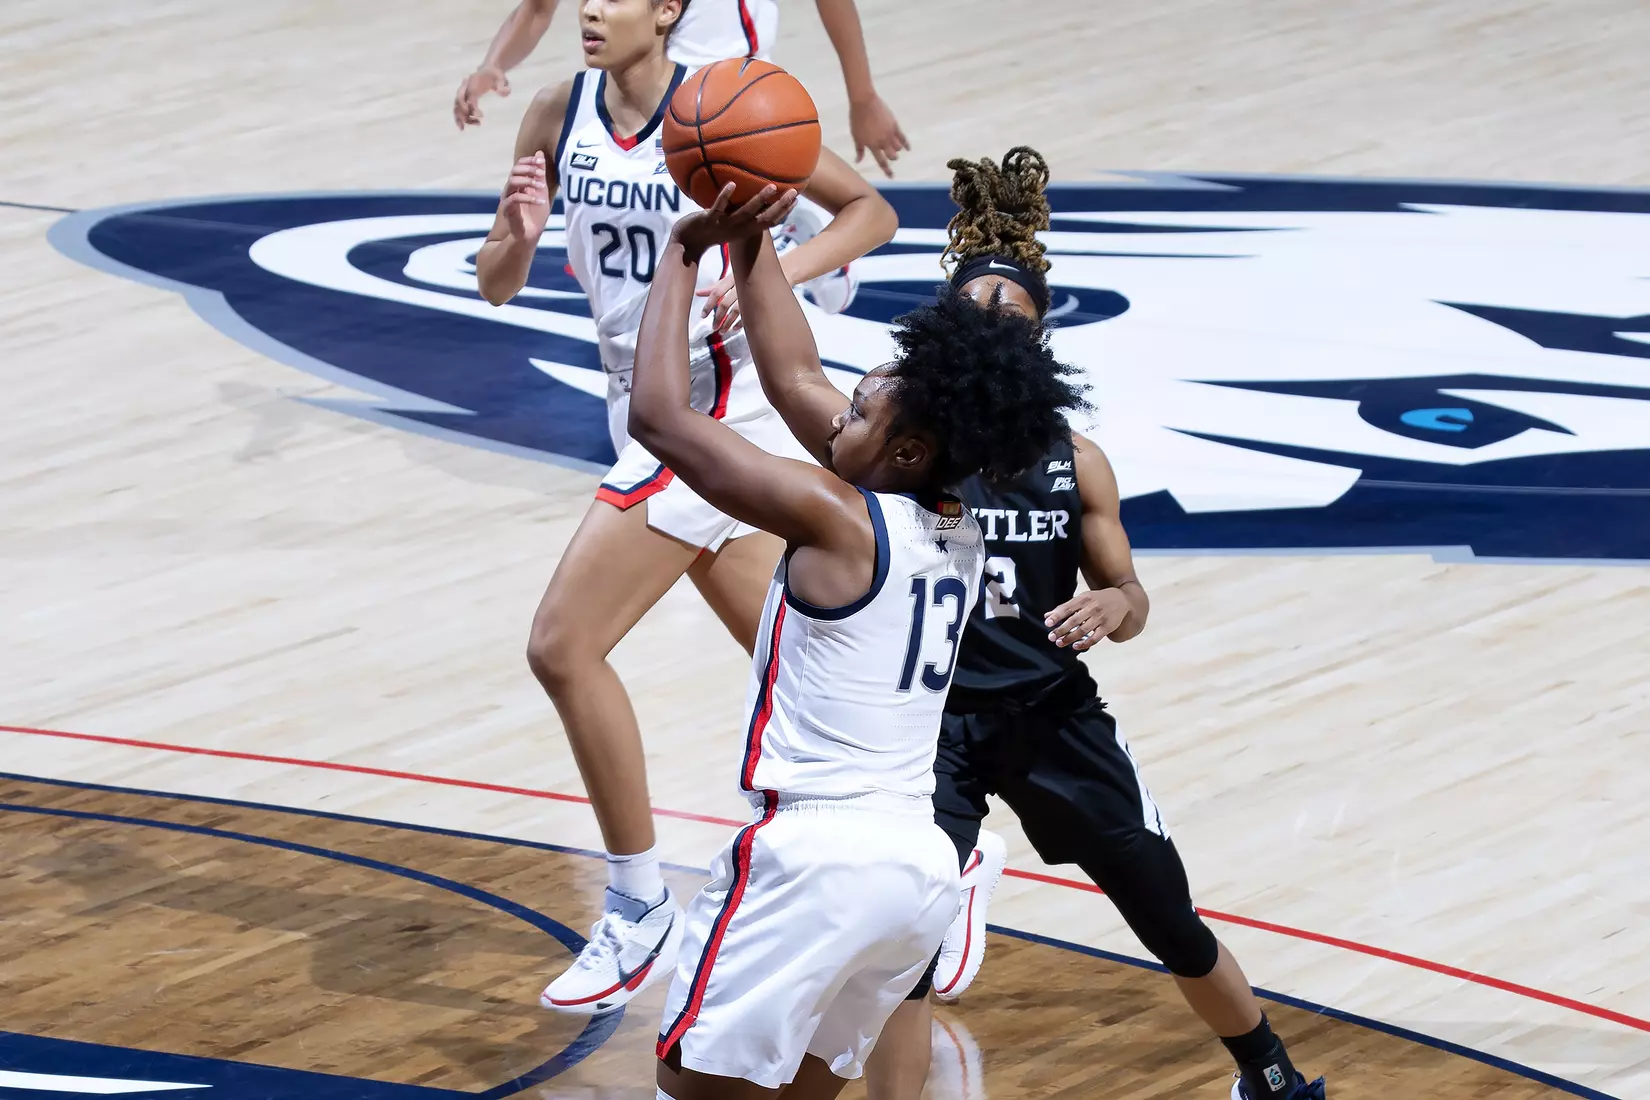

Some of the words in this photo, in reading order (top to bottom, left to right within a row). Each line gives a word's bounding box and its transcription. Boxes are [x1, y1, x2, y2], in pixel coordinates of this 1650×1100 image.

[567, 174, 680, 212] UCONN
[591, 222, 656, 283] 20
[1047, 460, 1072, 471] BLM
[936, 517, 962, 529] DEE
[984, 556, 1020, 620] 2
[896, 575, 969, 693] 13
